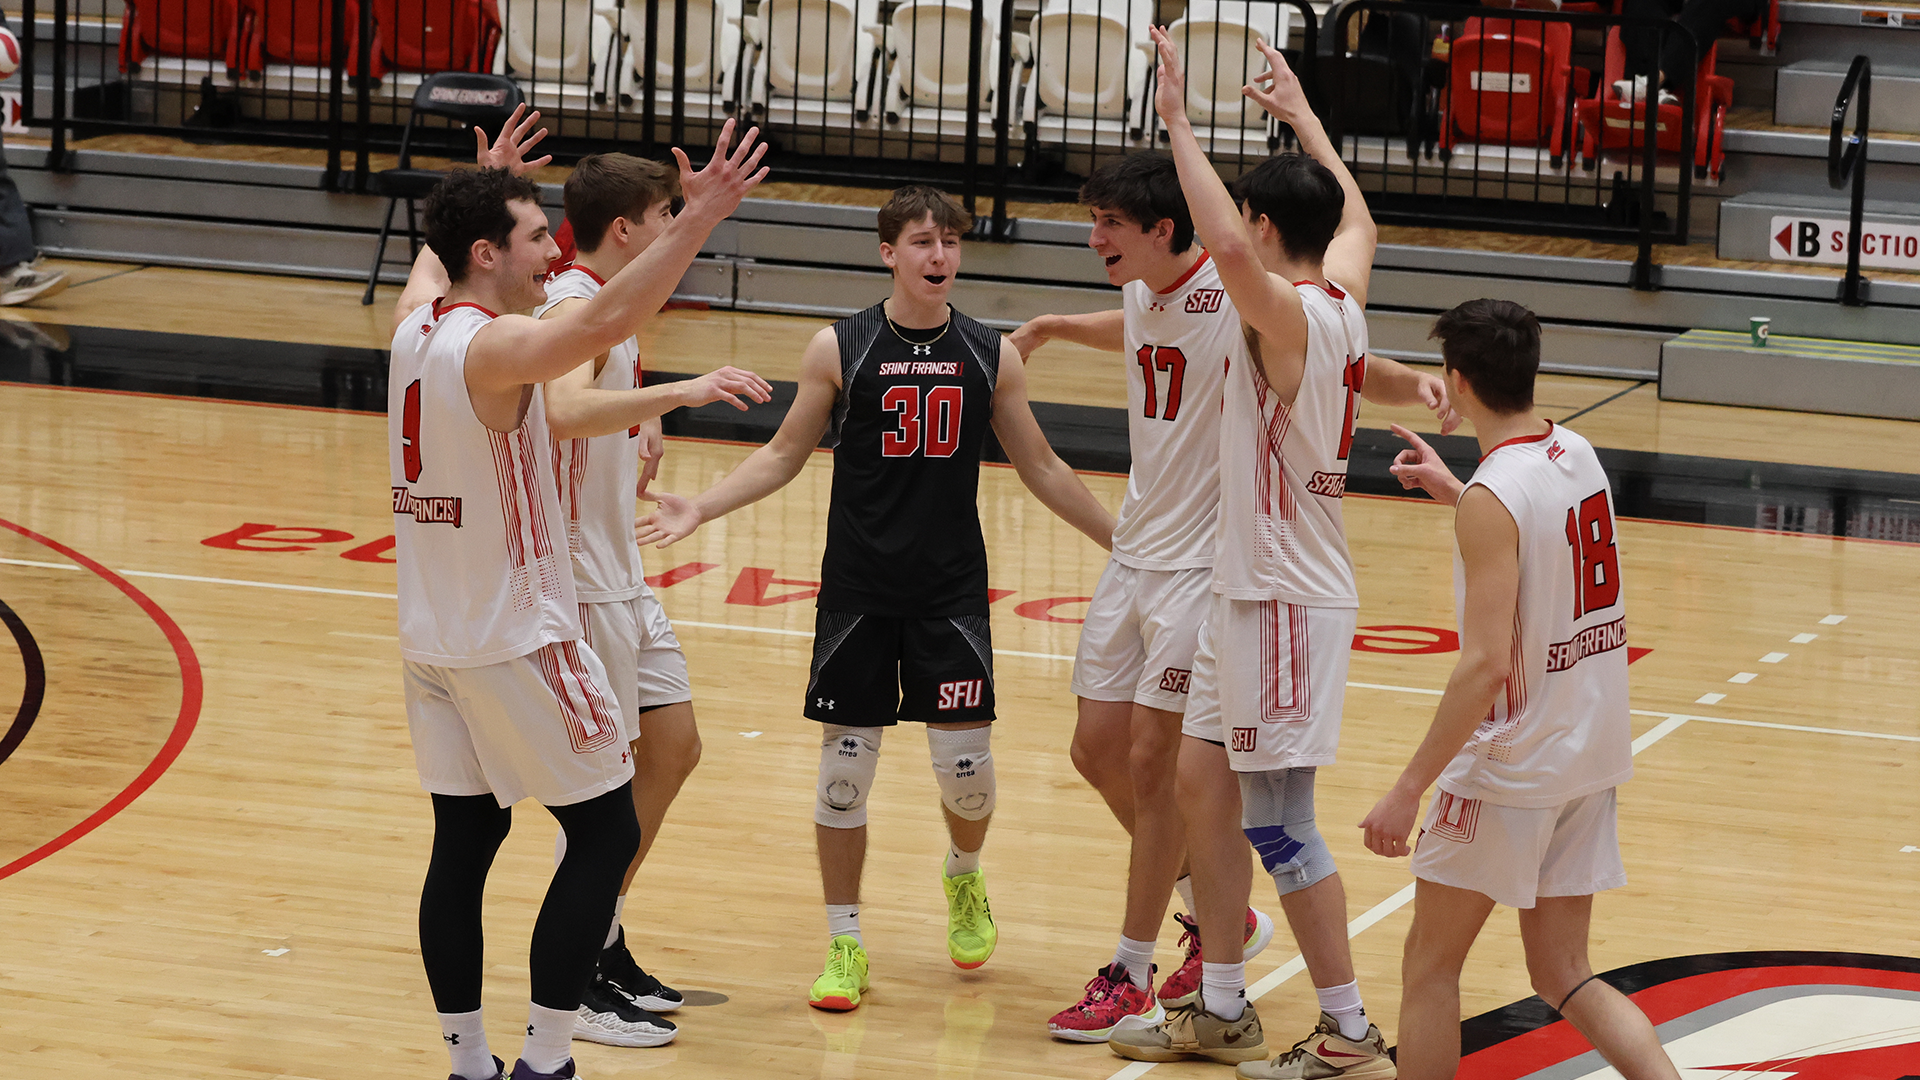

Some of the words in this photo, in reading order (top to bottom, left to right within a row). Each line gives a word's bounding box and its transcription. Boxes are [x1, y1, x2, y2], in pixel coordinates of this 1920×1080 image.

[1797, 221, 1821, 258] B
[1830, 230, 1918, 258] SCTIO
[1184, 288, 1225, 313] SFU
[879, 361, 911, 376] SAINT
[1136, 343, 1187, 422] 17
[882, 385, 963, 458] 30
[1565, 489, 1621, 623] 18
[937, 678, 984, 711] SFU
[1231, 727, 1258, 752] SFU
